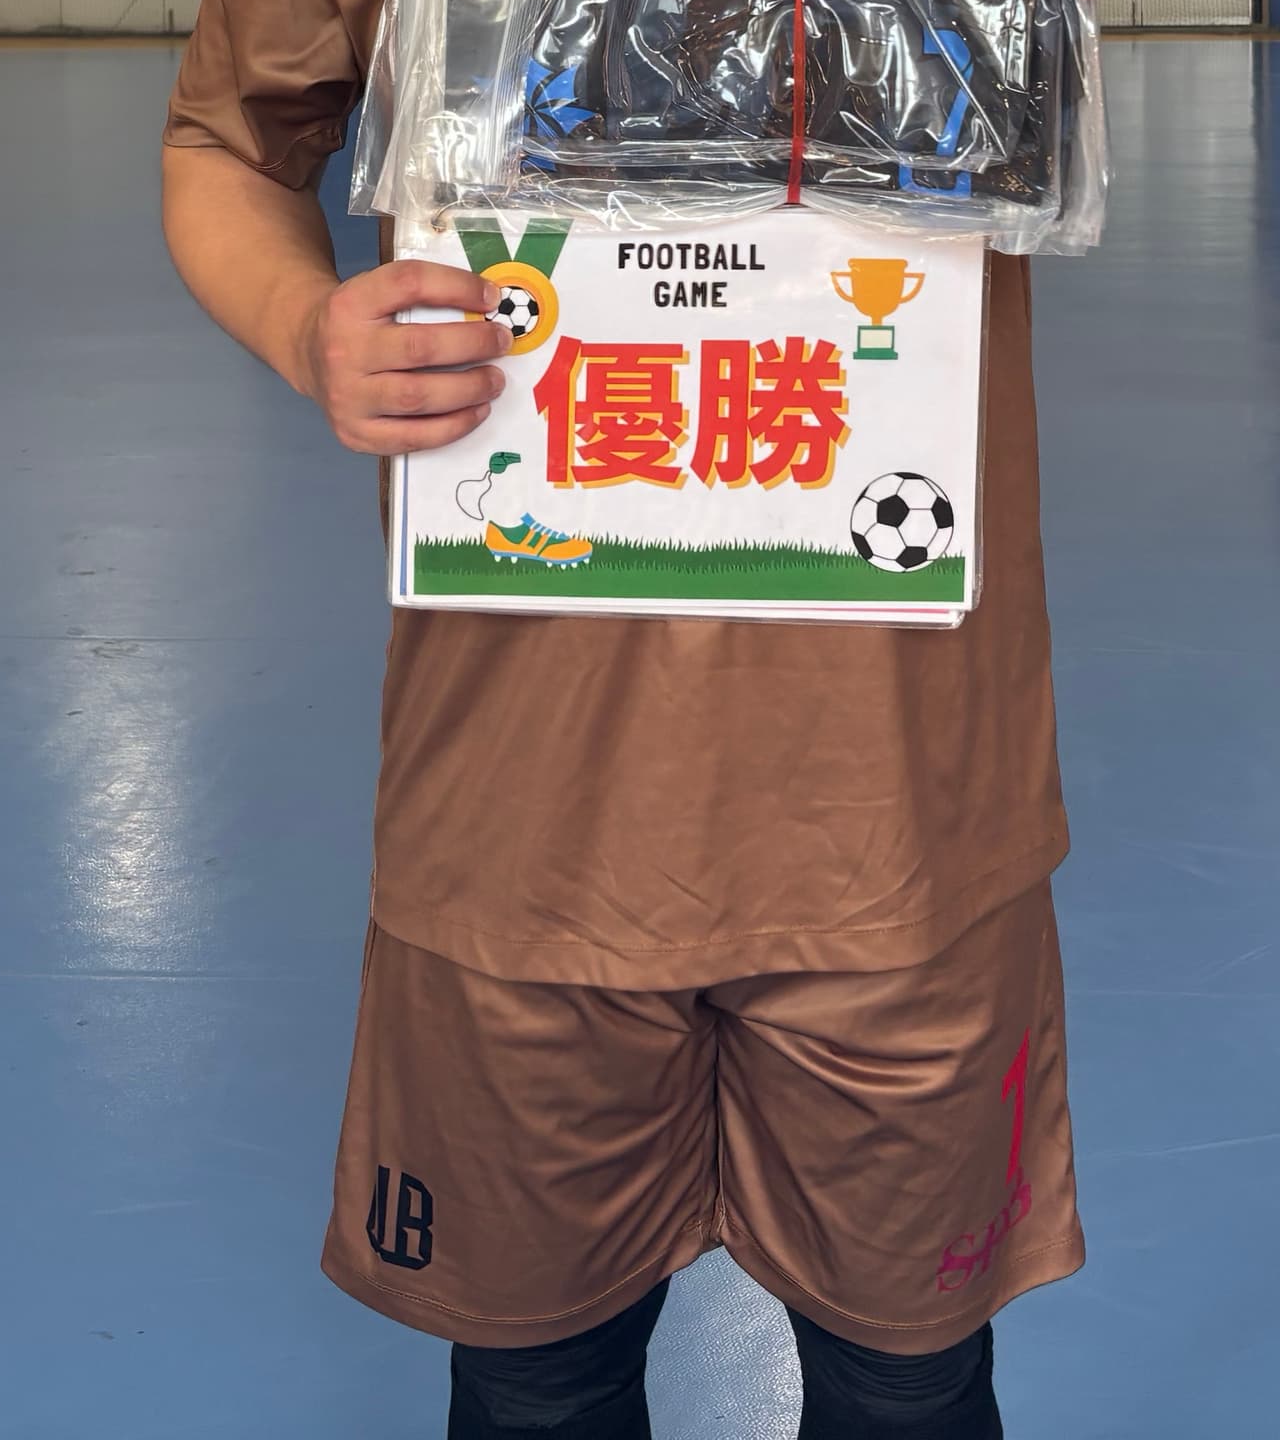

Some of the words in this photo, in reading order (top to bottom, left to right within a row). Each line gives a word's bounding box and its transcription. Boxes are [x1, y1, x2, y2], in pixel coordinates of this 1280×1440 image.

[617, 242, 766, 271] FOOTBALL
[653, 280, 728, 308] GAME
[532, 335, 852, 490] 優勝
